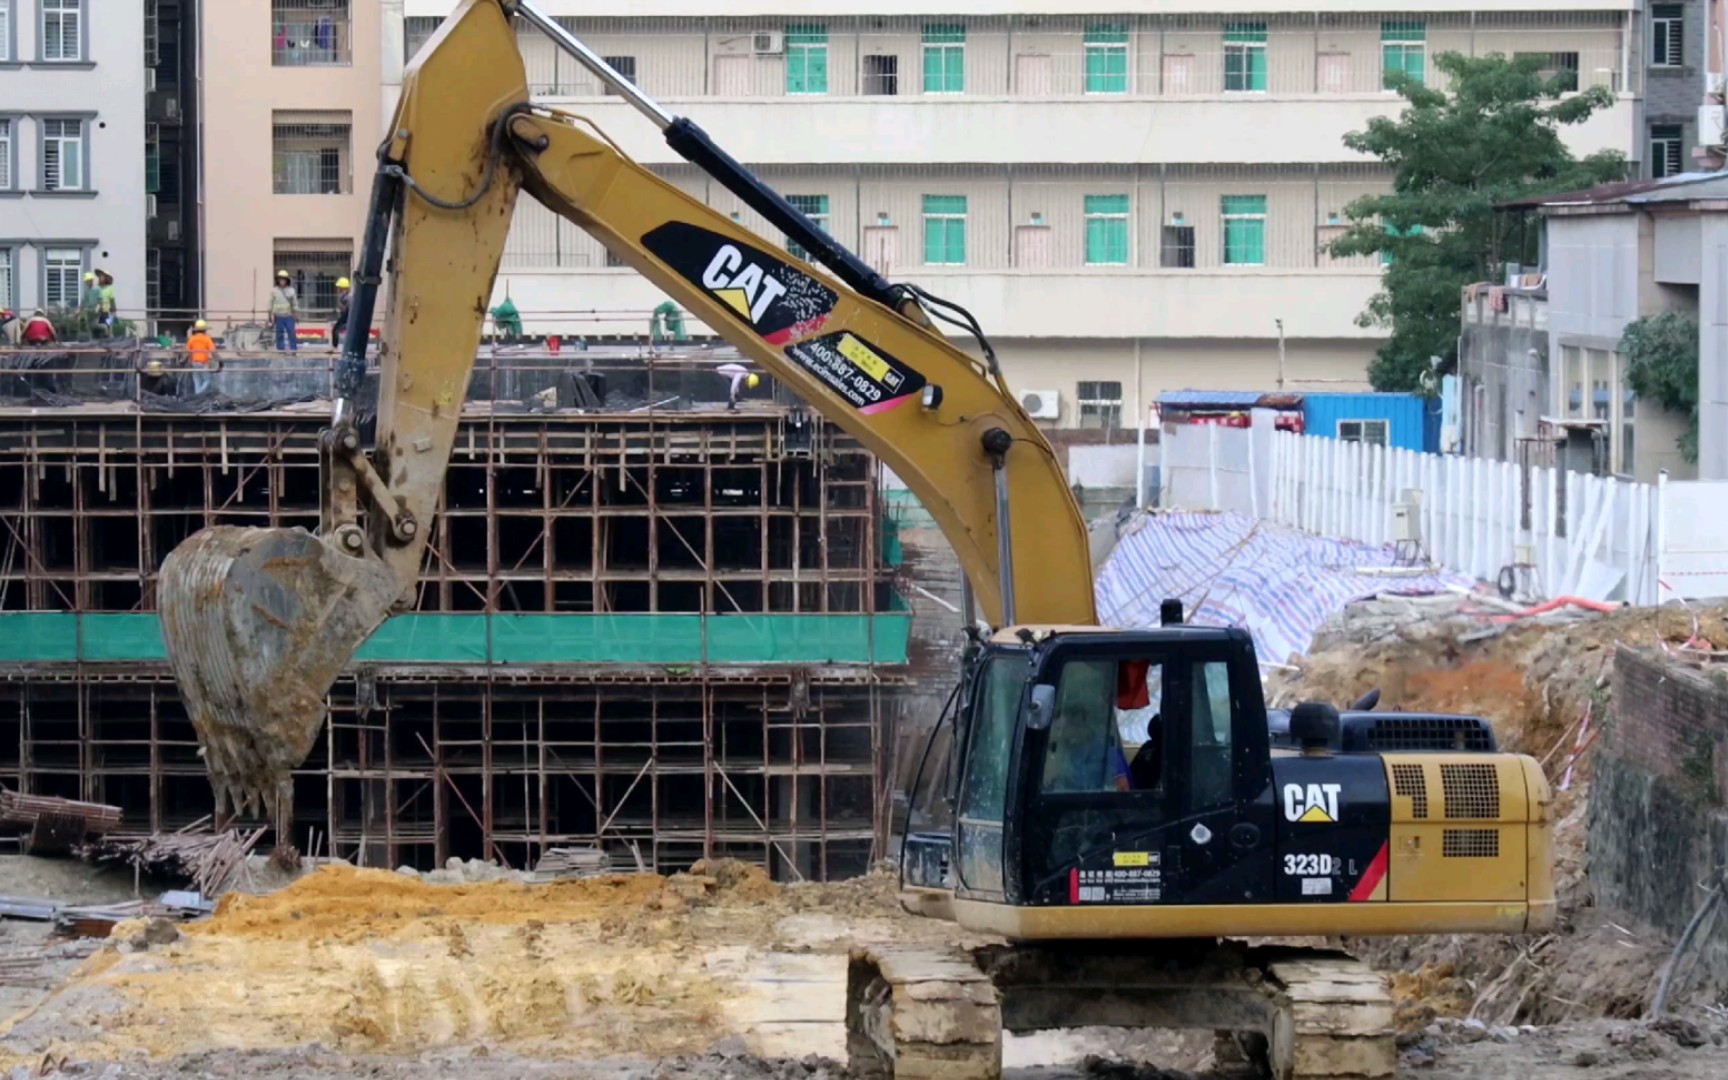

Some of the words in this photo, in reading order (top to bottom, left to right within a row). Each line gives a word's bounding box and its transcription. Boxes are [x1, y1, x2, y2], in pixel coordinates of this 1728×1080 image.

[702, 244, 787, 324] CAT
[809, 342, 882, 402] 400-887-0829
[1283, 783, 1342, 822] CAT
